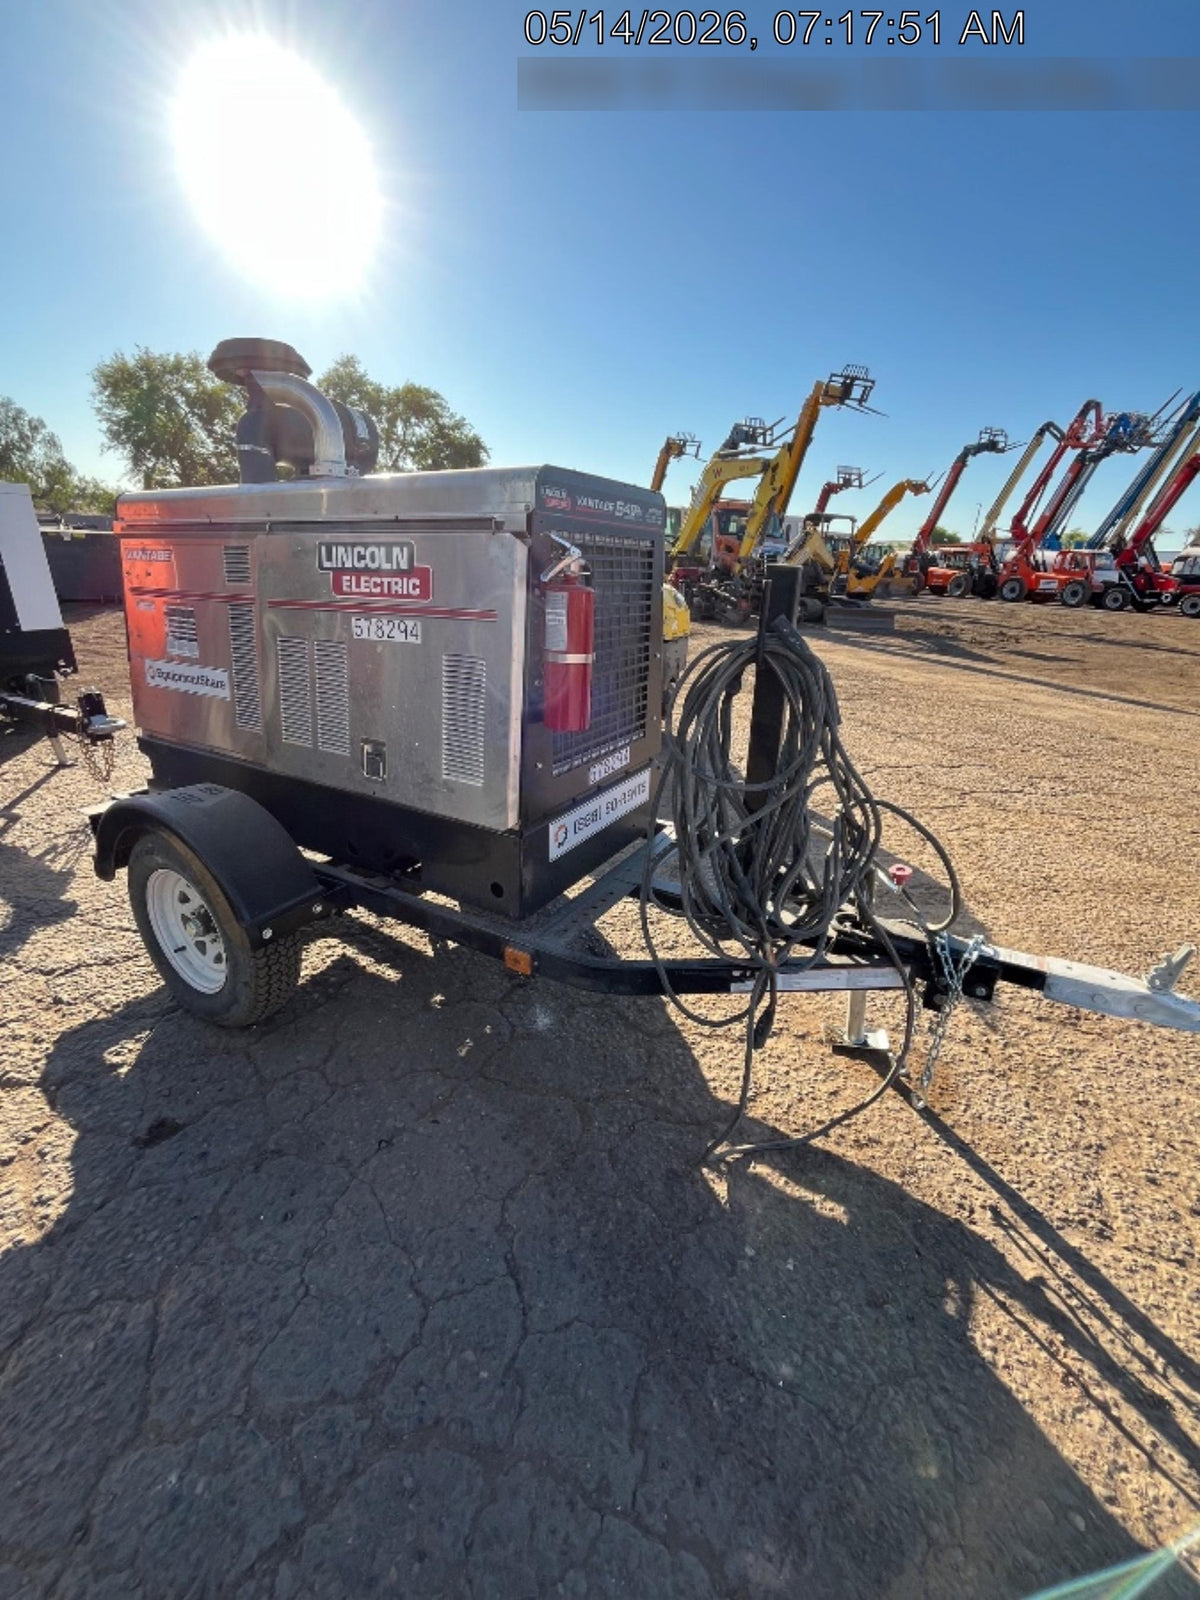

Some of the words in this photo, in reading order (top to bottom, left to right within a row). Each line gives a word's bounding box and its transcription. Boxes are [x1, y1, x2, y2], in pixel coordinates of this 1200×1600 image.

[321, 545, 409, 570] LINCOLN
[341, 575, 420, 596] ELECTRIC
[354, 618, 419, 640] 578294
